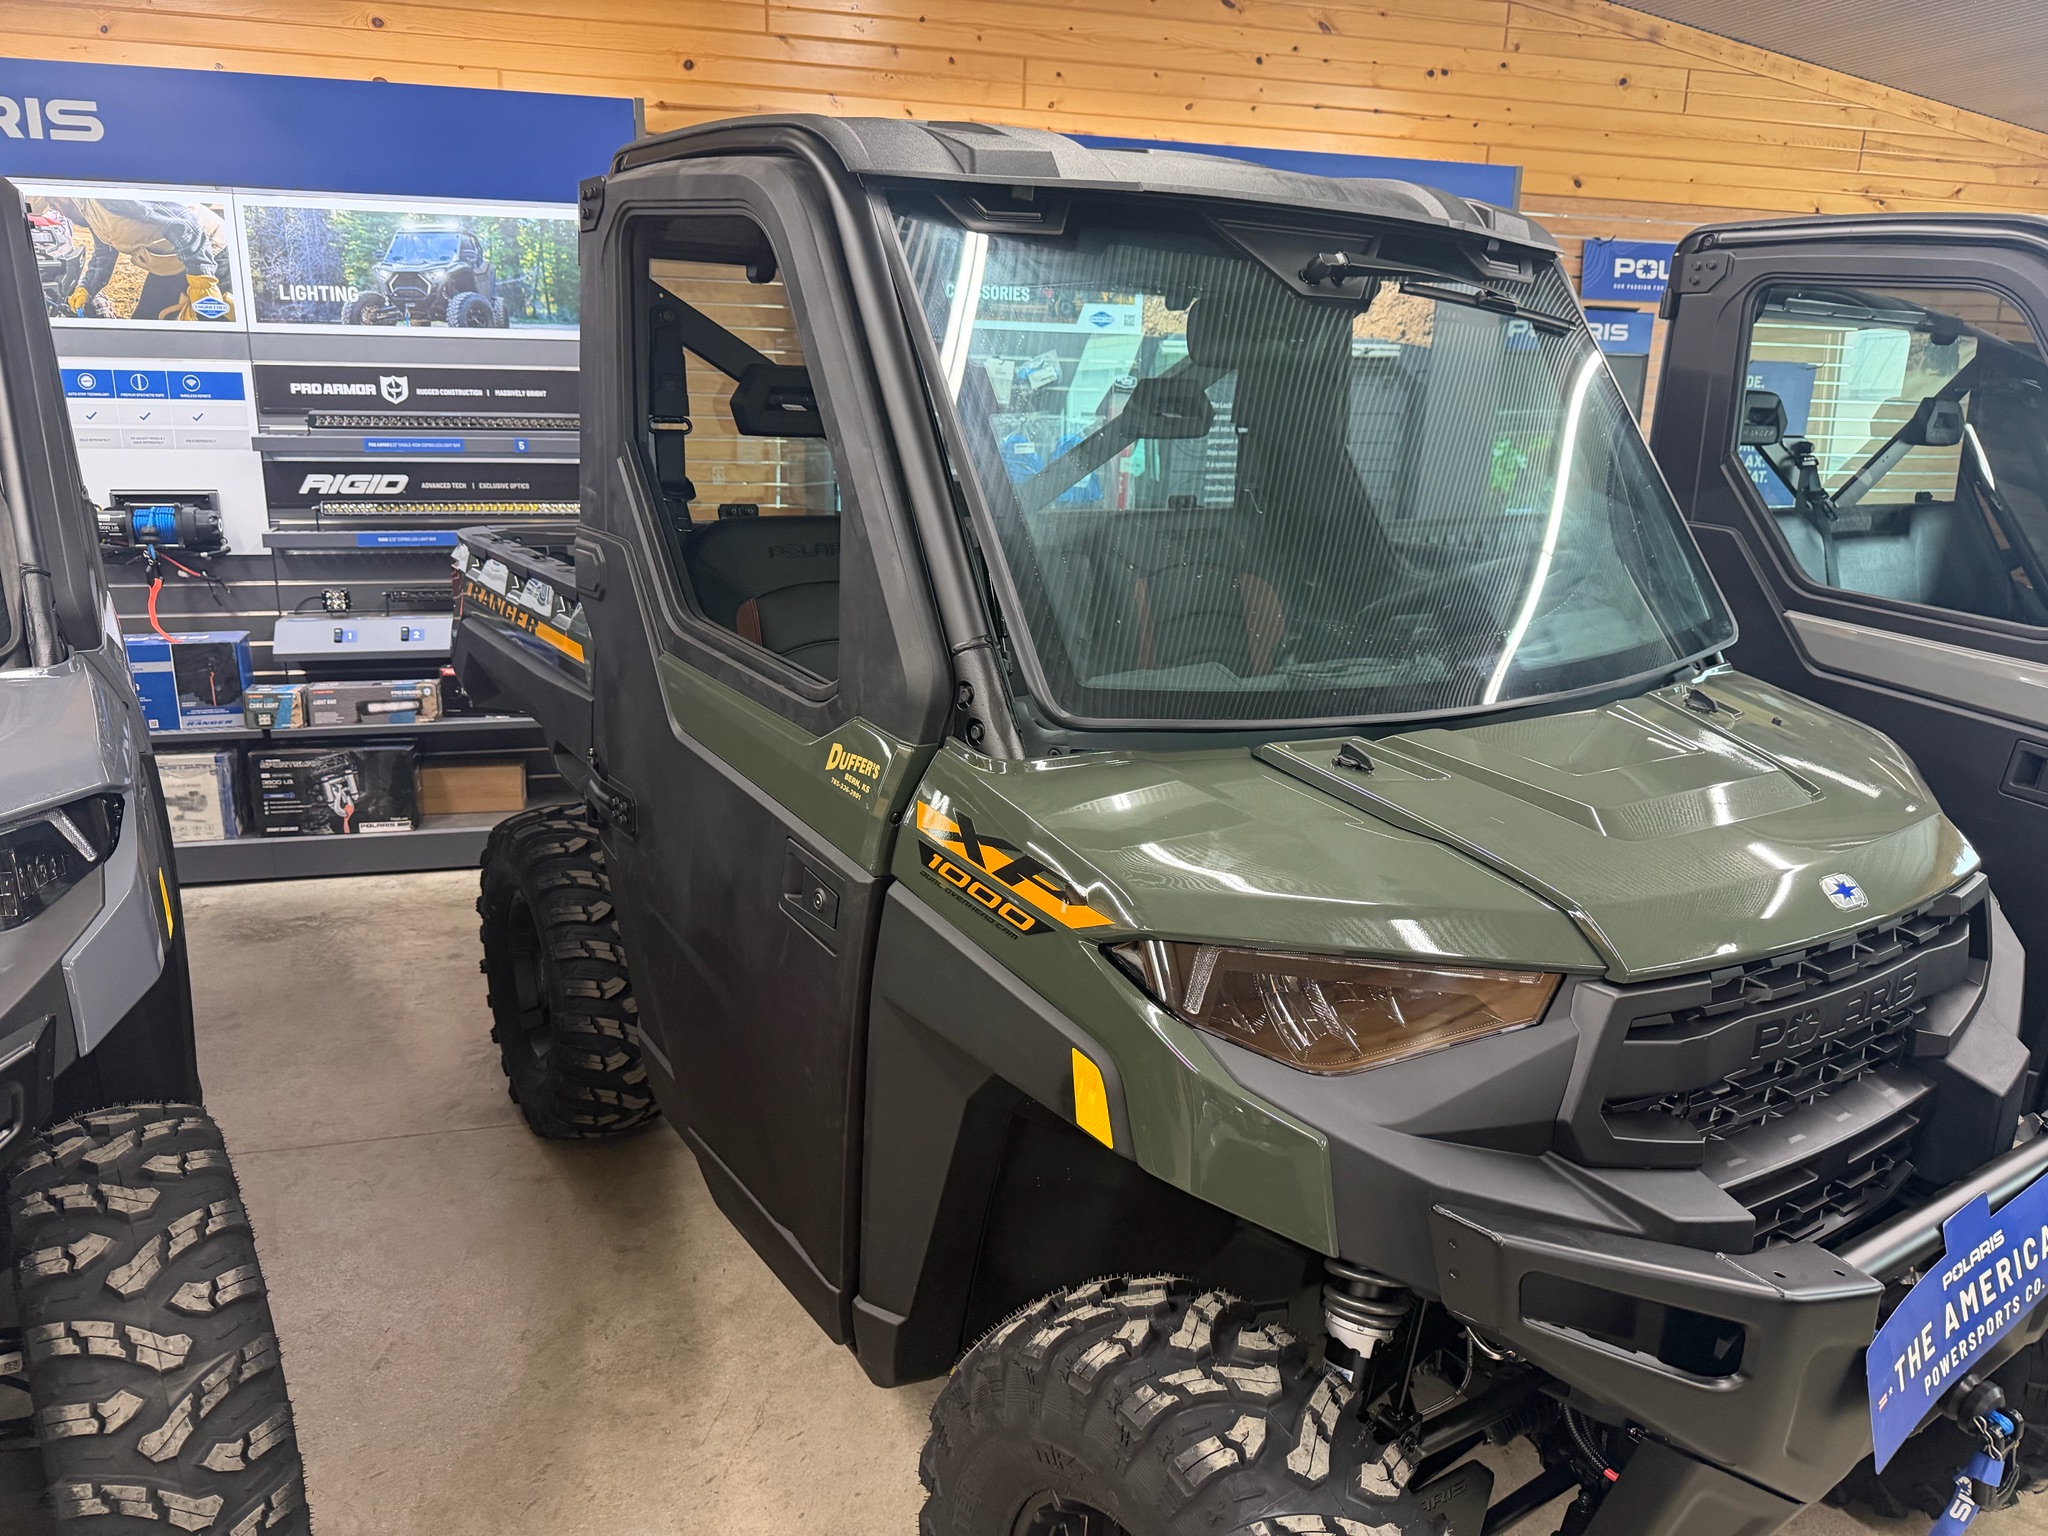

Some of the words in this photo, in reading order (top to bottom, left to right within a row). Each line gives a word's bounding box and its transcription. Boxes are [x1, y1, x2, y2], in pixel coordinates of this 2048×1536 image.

[278, 284, 360, 303] LIGHTING
[416, 388, 440, 396] RUGGED
[440, 388, 484, 397] CONSTRUCTION
[495, 389, 526, 397] MASSIVELY
[526, 390, 547, 398] BRIGHT
[517, 440, 525, 450] 5
[298, 473, 410, 495] RIGID
[347, 632, 352, 640] 1
[412, 630, 421, 639] 2
[824, 742, 881, 780] DUFFER'S
[861, 783, 871, 794] KS
[920, 869, 944, 889] DUAL
[944, 887, 995, 924] OVERHEAD
[995, 921, 1020, 940] CAM
[927, 852, 1036, 932] 1000
[1750, 963, 1919, 1060] POLARIS
[1942, 1229, 2006, 1292] POLARIS
[1924, 1295, 2021, 1397] POWERSPORTS
[2025, 1277, 2046, 1303] CO.
[1894, 1321, 1936, 1393] THE
